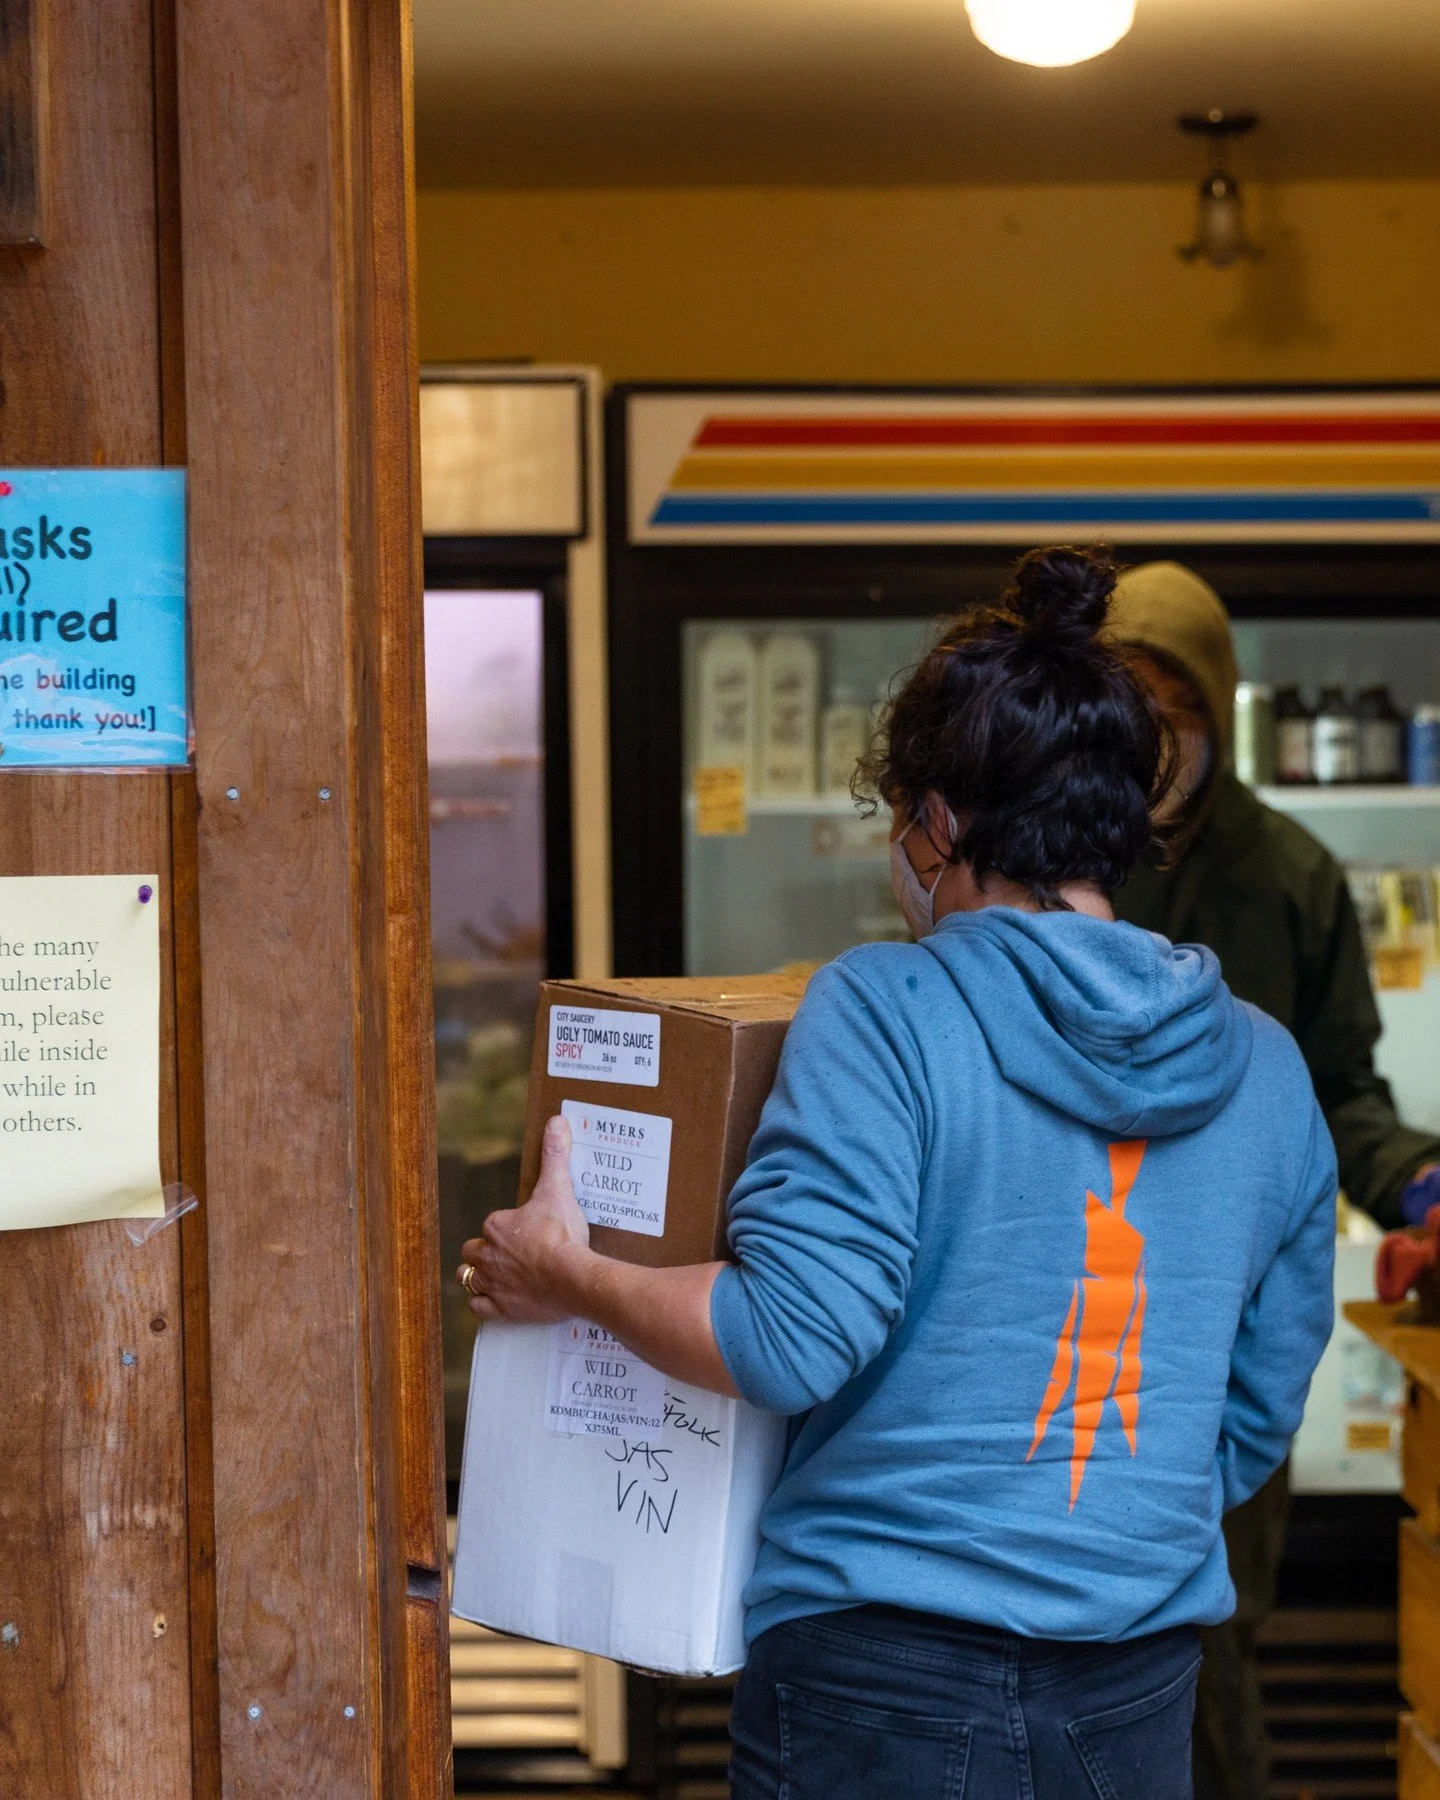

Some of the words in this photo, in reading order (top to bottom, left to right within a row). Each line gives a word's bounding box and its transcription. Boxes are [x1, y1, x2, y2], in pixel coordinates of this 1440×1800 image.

[37, 667, 136, 697] building
[12, 707, 84, 729] thank
[94, 705, 156, 735] you!]
[33, 941, 100, 963] many
[32, 1005, 105, 1034] please
[556, 1011, 570, 1021] CITY
[570, 1013, 595, 1024] SAUCERY
[556, 1026, 581, 1042] UGLY
[582, 1028, 620, 1046] TOMATO
[623, 1032, 654, 1050] SAUCE
[0, 1040, 30, 1062] ile
[39, 1038, 108, 1061] inside
[555, 1042, 583, 1059] SPICY
[602, 1052, 609, 1062] 26
[3, 1075, 66, 1097] while
[74, 1074, 97, 1096] in
[3, 1110, 82, 1133] others.
[596, 1120, 645, 1140] MYERS
[598, 1134, 641, 1148] PRODUCE
[593, 1151, 633, 1172] WILD
[580, 1171, 642, 1196] CARROT
[575, 1197, 659, 1223] CE:UGLY:SPICY:6X
[584, 1359, 627, 1379] WILD
[571, 1381, 637, 1402] CARROT
[584, 1423, 622, 1437] X375ML
[605, 1439, 673, 1482] JAS
[617, 1470, 679, 1534] VIN
